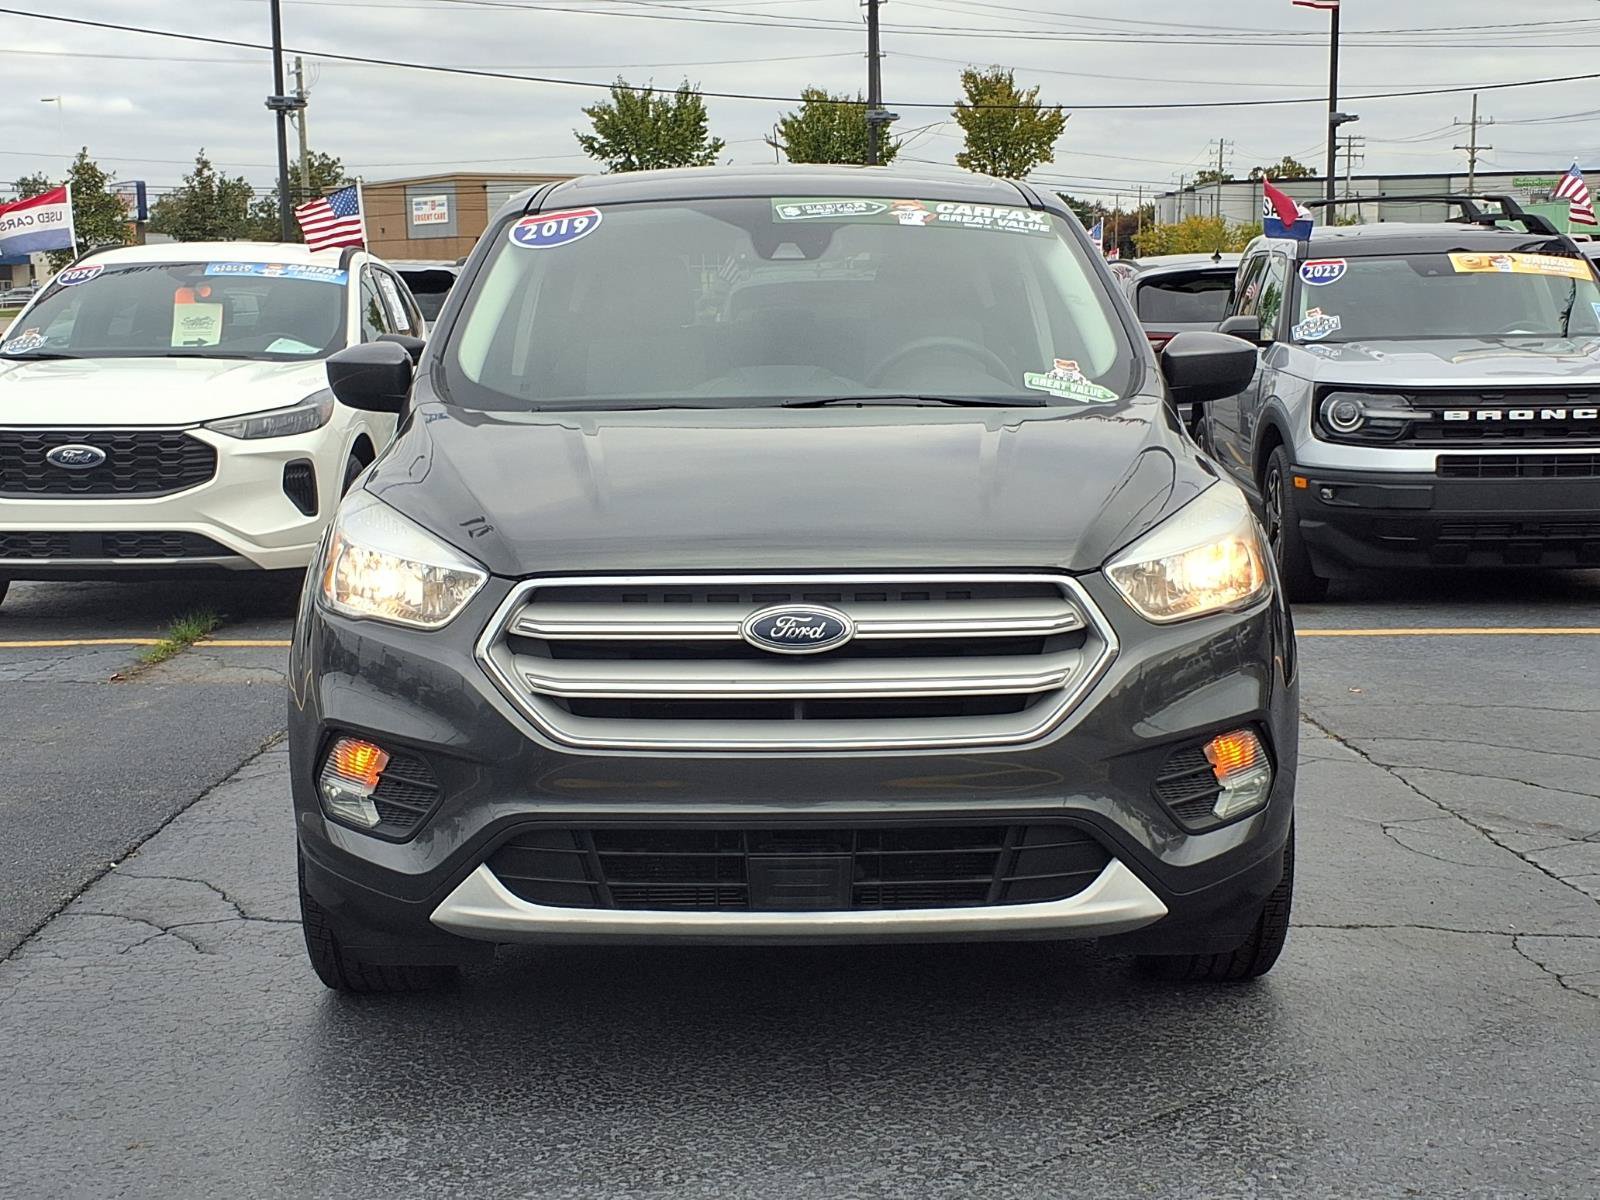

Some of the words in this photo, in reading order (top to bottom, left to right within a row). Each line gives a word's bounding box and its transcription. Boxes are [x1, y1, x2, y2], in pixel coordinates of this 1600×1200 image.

[935, 203, 1046, 223] CARFAX
[522, 217, 589, 240] 2019
[938, 213, 995, 225] GREAT
[997, 218, 1050, 233] VALUE
[61, 269, 97, 281] 2024
[287, 264, 345, 277] CARFAX
[1305, 265, 1340, 278] 2023
[1031, 376, 1067, 390] GREAT
[1070, 384, 1104, 398] VALUE
[1443, 408, 1598, 420] BRONC
[60, 450, 92, 463] Ford
[770, 615, 827, 639] Ford
